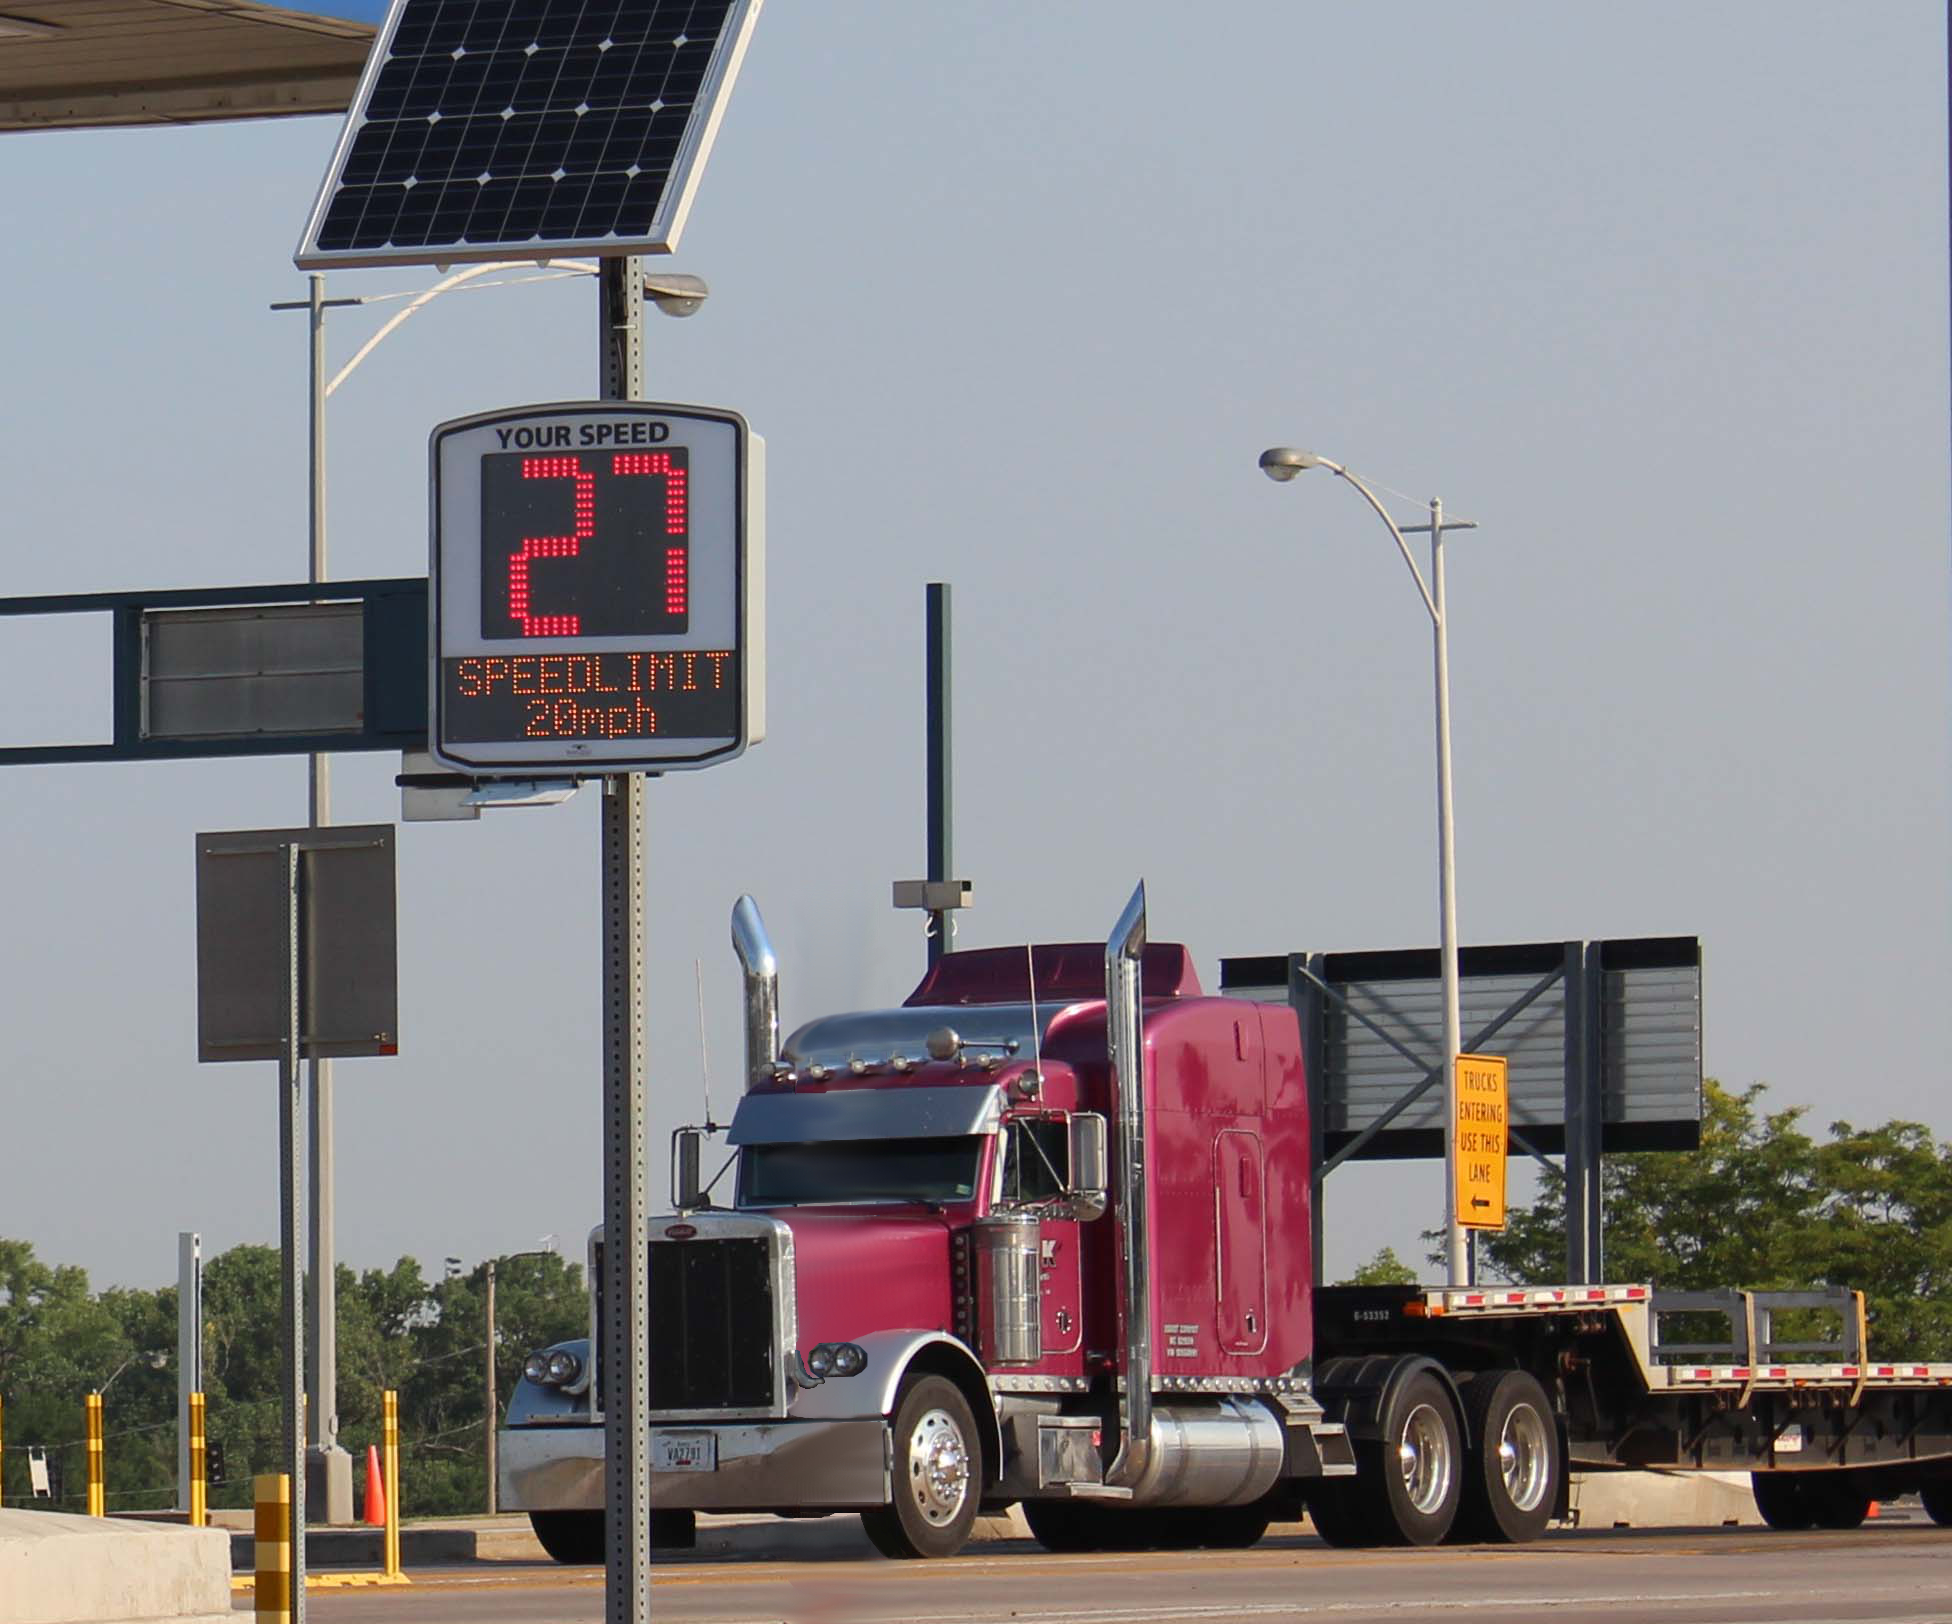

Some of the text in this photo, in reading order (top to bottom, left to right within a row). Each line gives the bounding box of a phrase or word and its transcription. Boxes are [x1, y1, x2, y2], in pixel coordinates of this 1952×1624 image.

[496, 422, 670, 449] YOUR SPEED
[509, 453, 687, 638] 27
[526, 697, 657, 739] 20mph
[1464, 1071, 1498, 1092] TRUCKS
[1459, 1102, 1503, 1123] ENTERING
[1460, 1132, 1500, 1153] USE THIS
[1469, 1164, 1491, 1183] LANE
